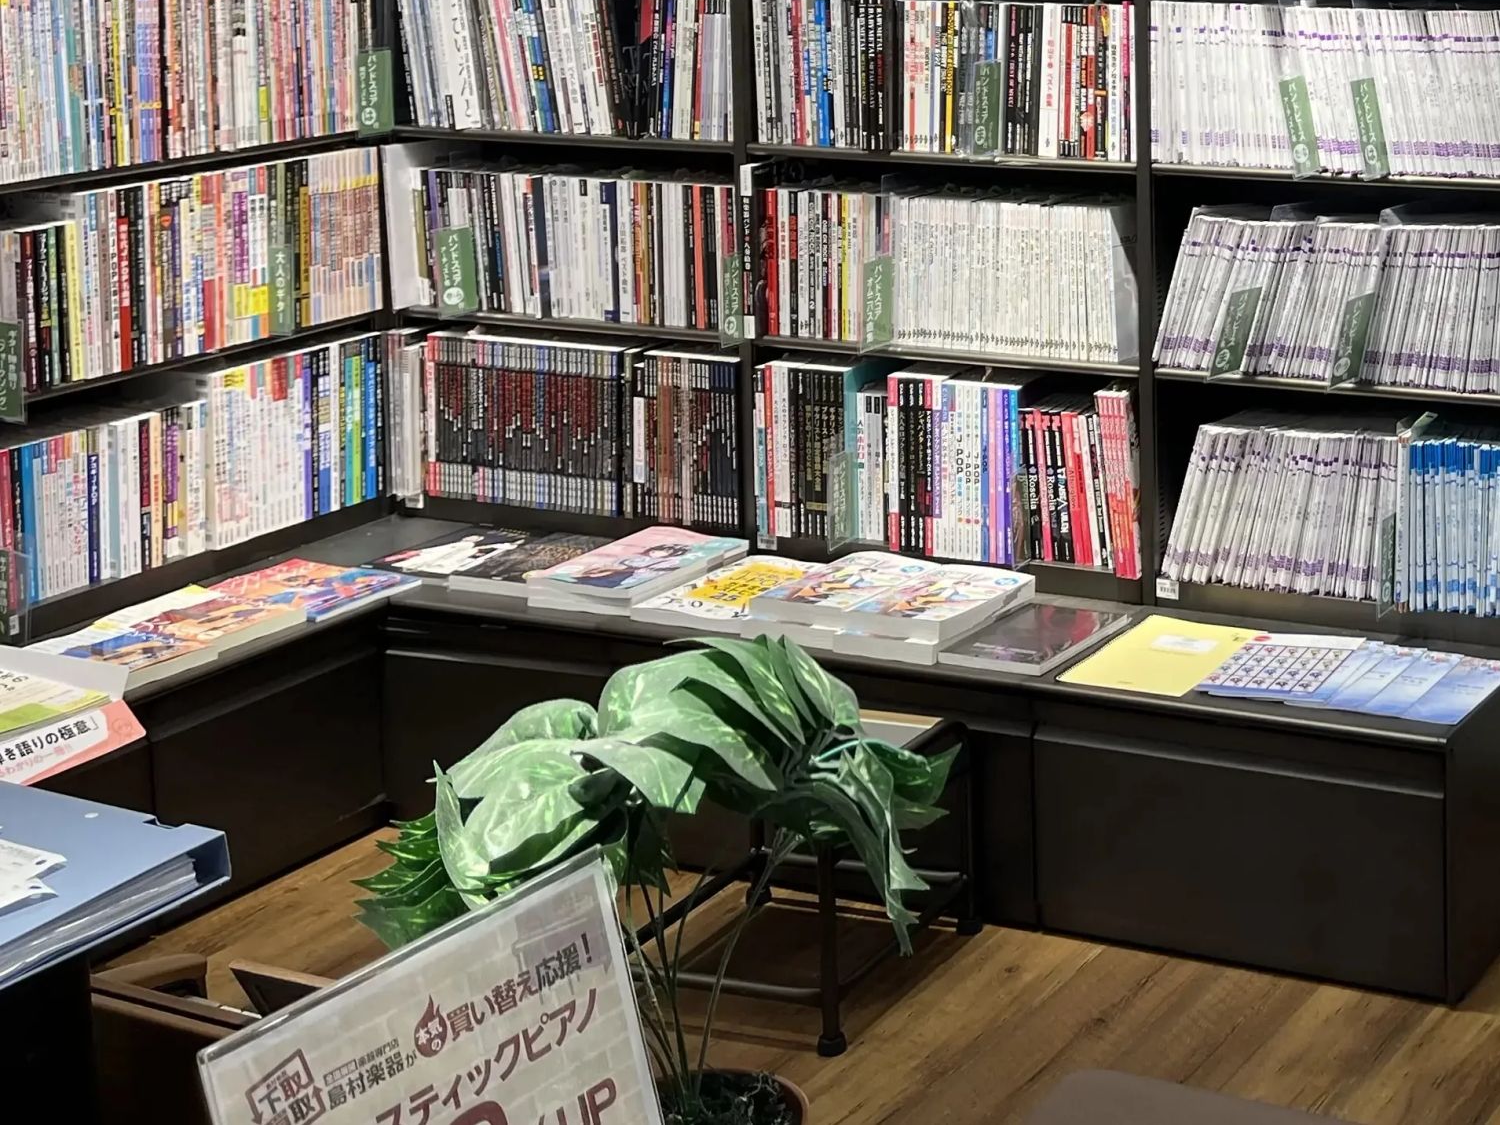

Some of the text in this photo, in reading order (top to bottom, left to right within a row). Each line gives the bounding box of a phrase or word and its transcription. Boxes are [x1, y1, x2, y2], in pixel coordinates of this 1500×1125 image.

[368, 55, 379, 107] バンドスコア
[979, 65, 990, 125] バンドスコア
[809, 220, 814, 231] OK
[822, 234, 827, 244] OK
[447, 233, 462, 287] バンドスコア
[275, 250, 286, 325] 大人のギター
[730, 258, 740, 315] バンドスコア
[874, 263, 884, 321] バンドスコア
[1029, 475, 1038, 510] Roselia
[1047, 475, 1056, 510] Roselia
[1069, 469, 1077, 509] Afterglow
[415, 1019, 446, 1052] 本気の
[258, 1069, 303, 1115] 下取
[329, 1049, 417, 1110] 島村楽器が
